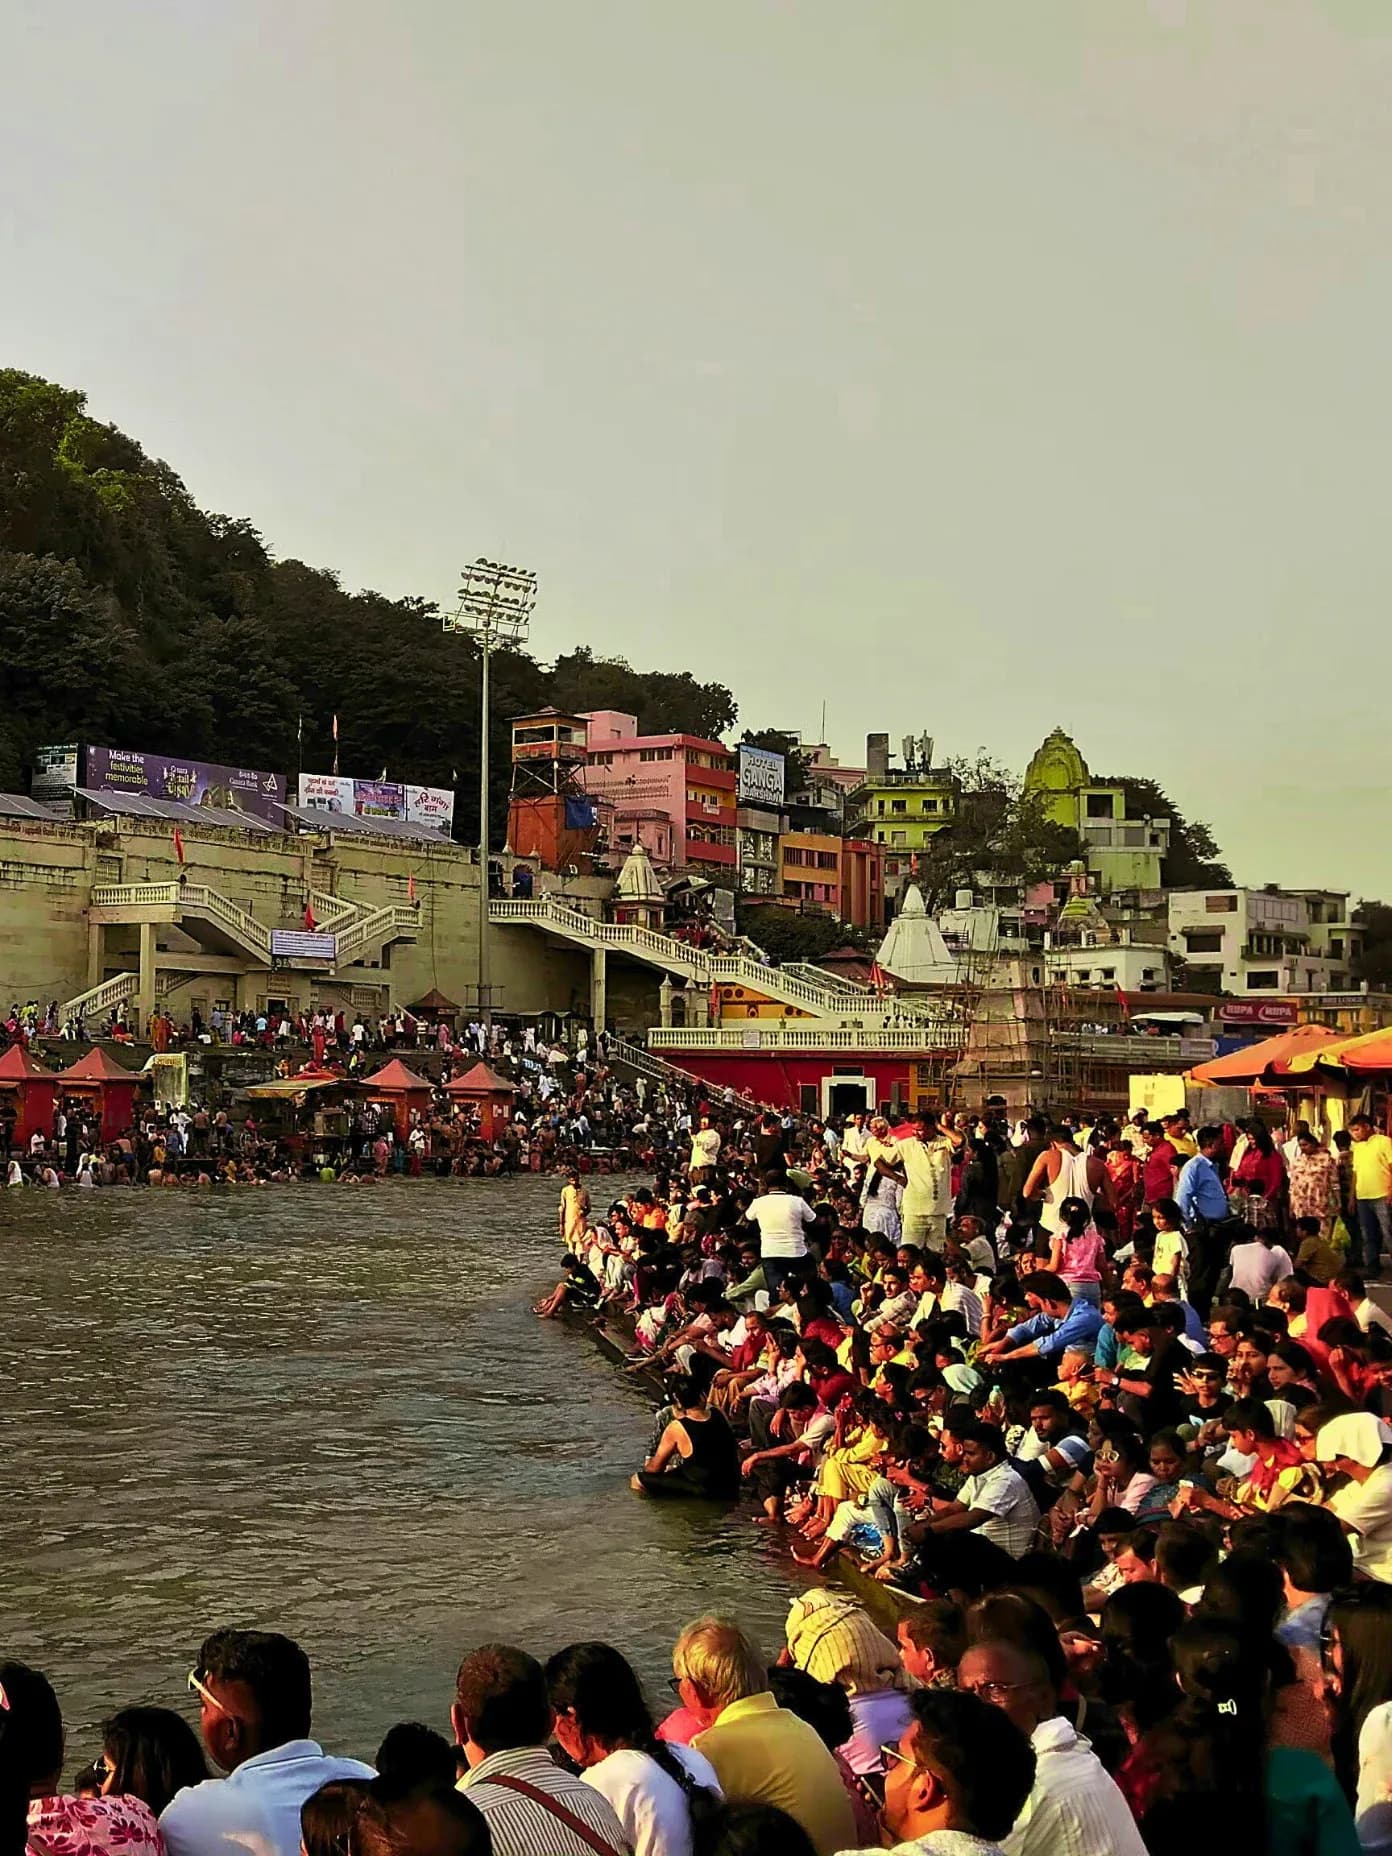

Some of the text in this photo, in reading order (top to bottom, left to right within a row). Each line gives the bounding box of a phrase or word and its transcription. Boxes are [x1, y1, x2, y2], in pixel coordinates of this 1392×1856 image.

[108, 749, 145, 764] Make the
[747, 756, 777, 769] HOTEL
[110, 760, 144, 774] festivities
[105, 772, 149, 786] memorable
[742, 767, 783, 793] GANGA
[1226, 1004, 1292, 1016] RUPA RUPA
